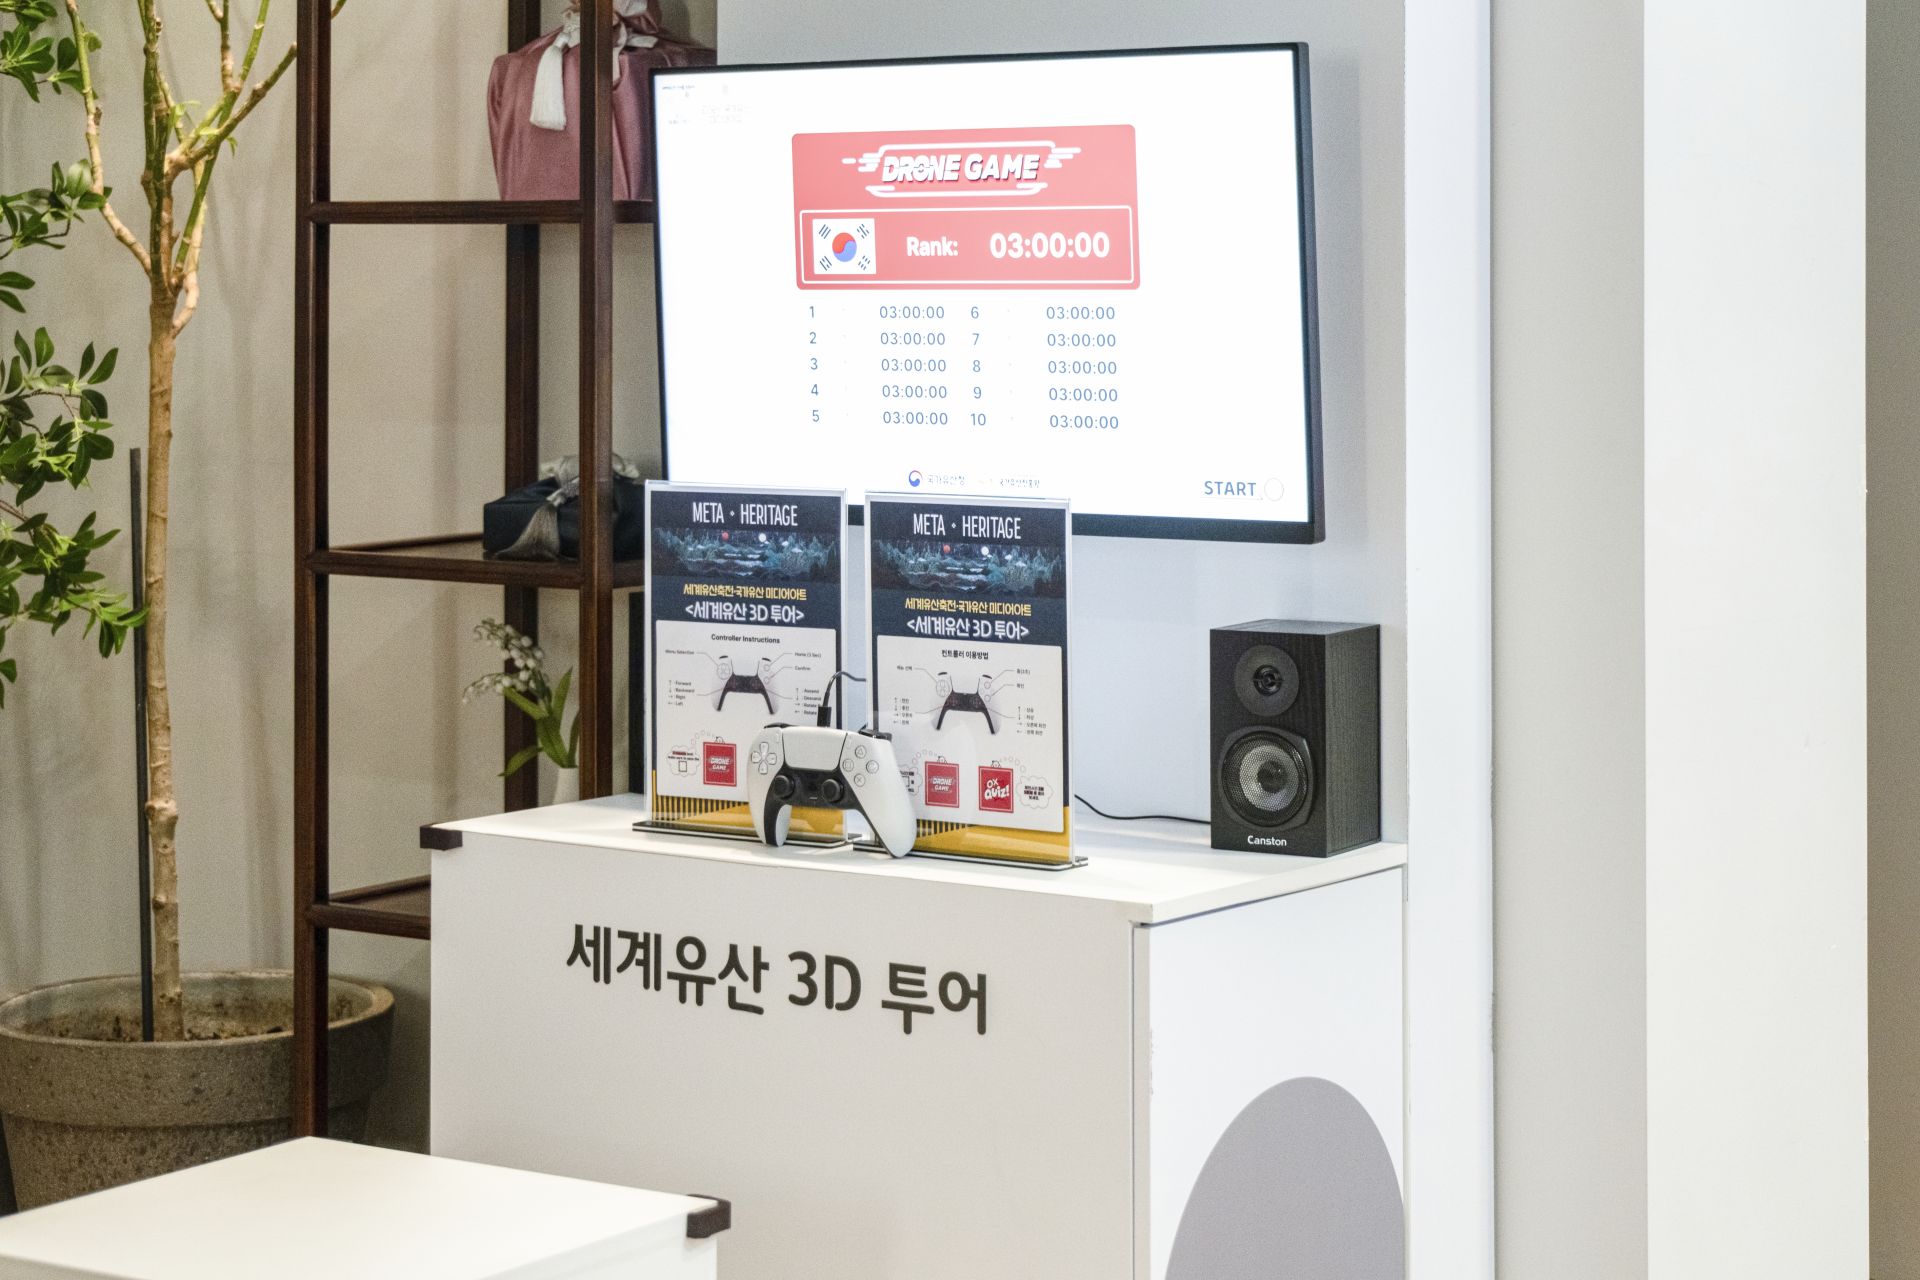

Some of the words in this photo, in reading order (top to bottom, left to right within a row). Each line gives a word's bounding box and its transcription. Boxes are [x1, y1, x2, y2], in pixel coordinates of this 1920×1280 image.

[881, 154, 961, 182] DRONE
[964, 152, 1041, 181] GAME
[906, 235, 959, 257] Rank:
[989, 231, 1110, 259] 03:00:00
[879, 305, 945, 319] 03:00:00
[970, 306, 980, 319] 6
[1046, 306, 1115, 320] 03:00:00
[809, 331, 817, 345] 2
[880, 332, 946, 346] 03:00:00
[972, 332, 980, 346] 7
[1047, 333, 1116, 348] 03:00:00
[810, 357, 818, 371] 3
[881, 358, 947, 372] 03:00:00
[972, 359, 981, 373] 8
[1047, 360, 1117, 375] 03:00:00
[810, 383, 819, 396] 4
[882, 384, 947, 399] 03:00:00
[973, 386, 982, 400] 9
[1048, 387, 1118, 402] 03:00:00
[812, 409, 820, 423] 5
[882, 411, 948, 426] 03:00:00
[970, 413, 987, 426] 10
[1049, 414, 1119, 430] 03:00:00
[1204, 480, 1257, 497] START
[692, 501, 724, 523] META
[740, 504, 798, 526] HERITAGE
[913, 513, 945, 536] META
[962, 515, 1021, 539] HERITAGE
[765, 587, 807, 600] 미디어아트
[749, 604, 768, 621] 3D
[770, 604, 804, 623] 투어>
[989, 601, 1031, 616] 미디어아트
[972, 619, 992, 637] 3D
[994, 620, 1030, 640] 투어>
[711, 633, 741, 642] Controller
[743, 635, 780, 644] Instructions
[941, 649, 965, 658] 컨트롤러
[965, 650, 989, 660] 이용방법
[709, 757, 732, 765] DRONE
[932, 777, 953, 786] DRONE
[1247, 834, 1288, 848] Canston
[567, 923, 770, 1015] 세계유산
[787, 949, 862, 1011] 3D
[881, 962, 987, 1035] 투어
